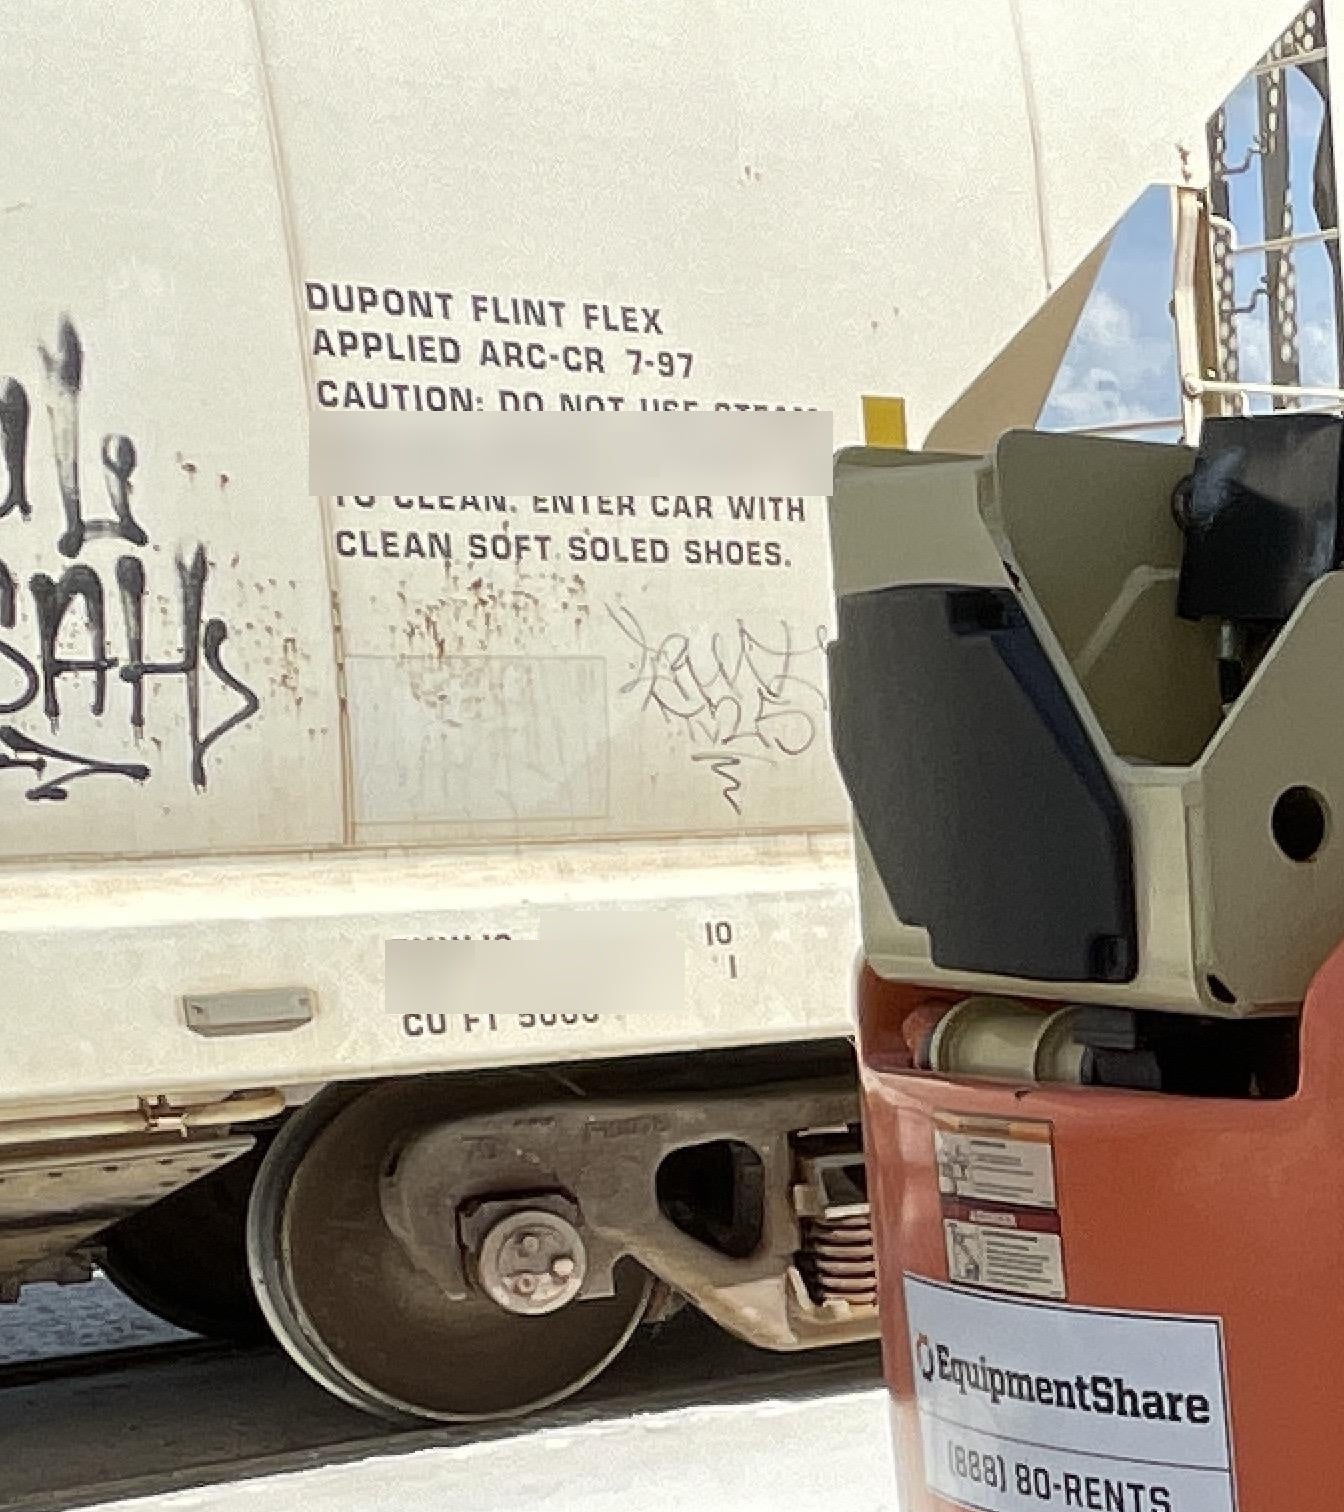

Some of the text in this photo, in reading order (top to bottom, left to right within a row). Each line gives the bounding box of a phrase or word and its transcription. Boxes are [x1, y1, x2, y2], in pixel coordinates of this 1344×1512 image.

[305, 283, 664, 335] DUPONT FLINT FLEX
[313, 329, 694, 379] APPLIED ARC-CR 7-97
[316, 380, 484, 412] CAUTION:
[651, 496, 713, 519] CAR
[727, 496, 806, 522] WITH
[336, 530, 793, 568] CLEAN SOFT SOLED SHOES.
[402, 1013, 447, 1036] CU
[936, 1344, 1210, 1425] EquipmentShare
[947, 1439, 1006, 1494] (888)
